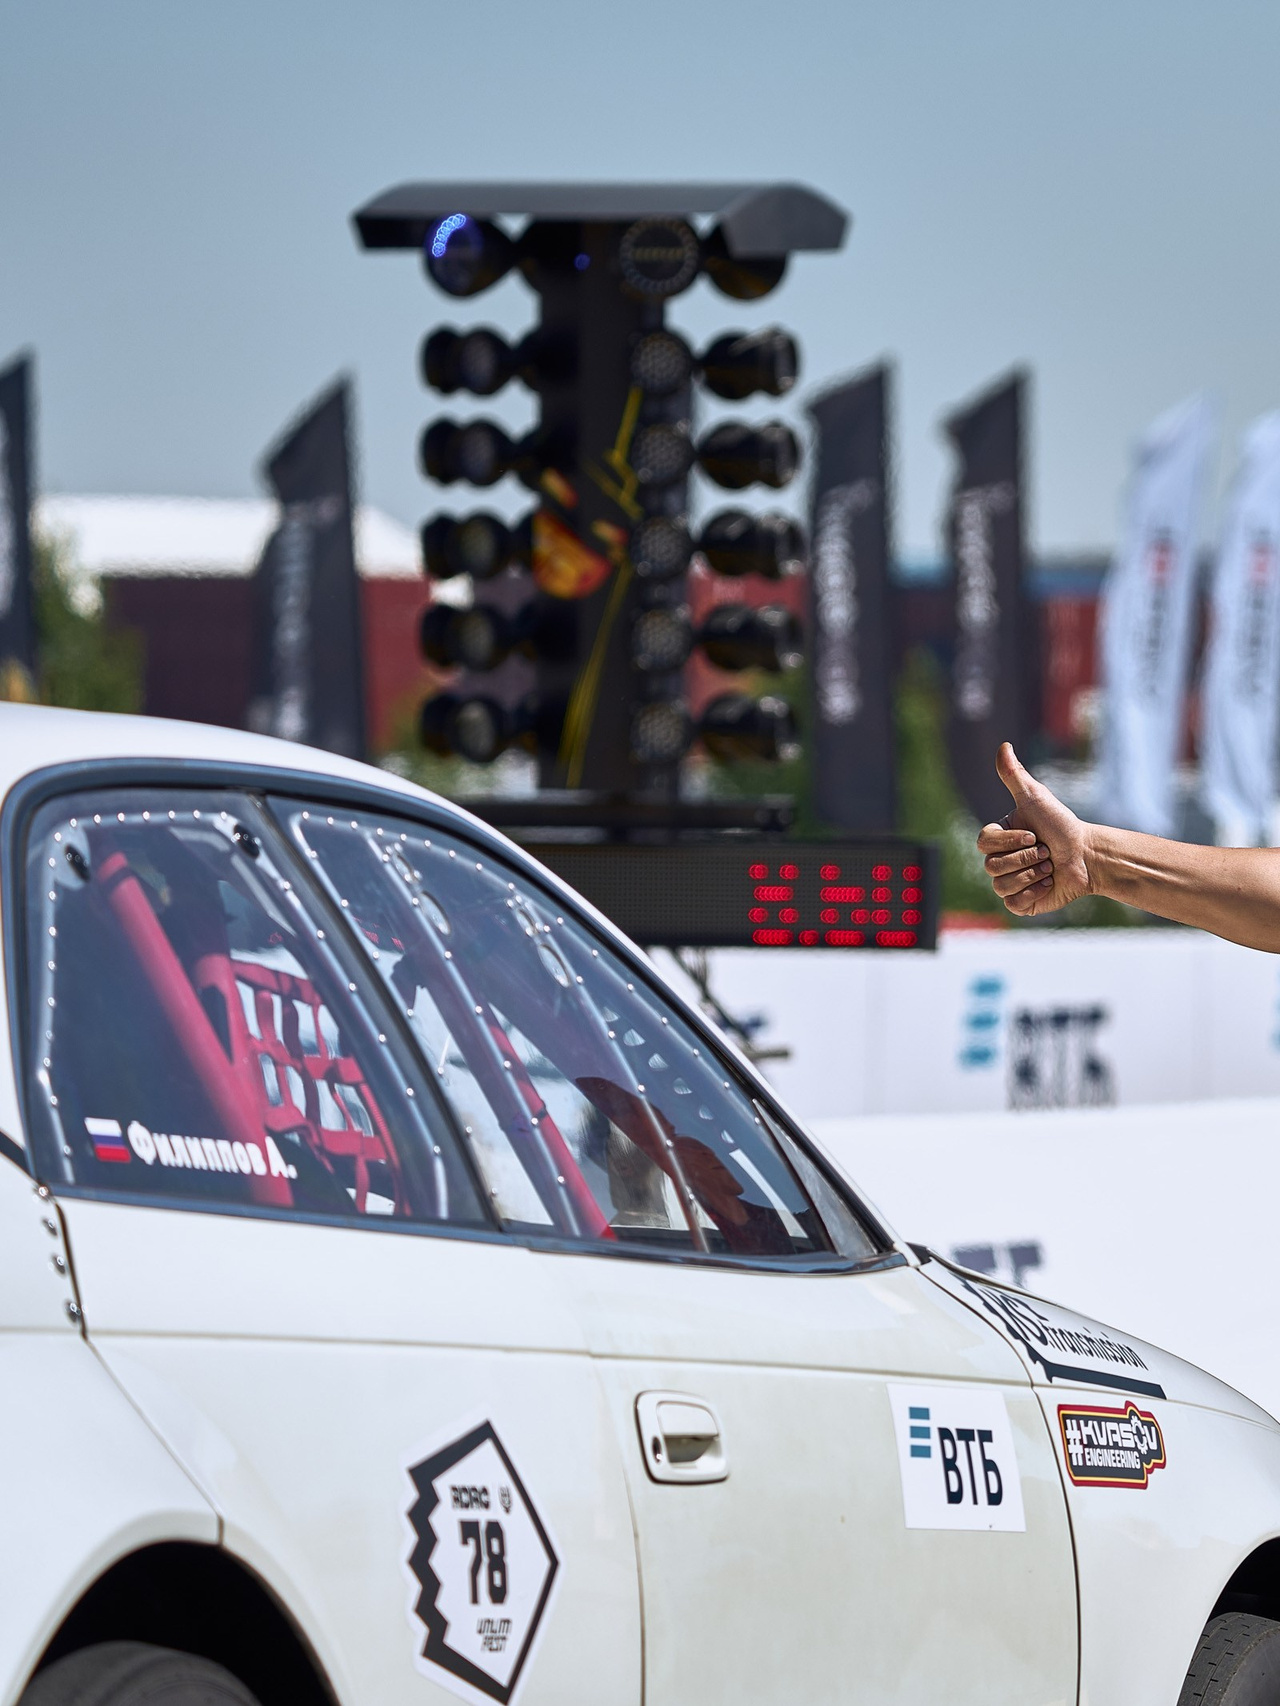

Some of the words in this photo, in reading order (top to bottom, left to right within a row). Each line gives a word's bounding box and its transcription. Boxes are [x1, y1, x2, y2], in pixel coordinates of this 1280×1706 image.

[127, 1120, 267, 1176] Филиппов
[937, 1427, 1003, 1506] ВТБ
[1084, 1447, 1141, 1469] ENGINEERING
[459, 1520, 508, 1605] 78
